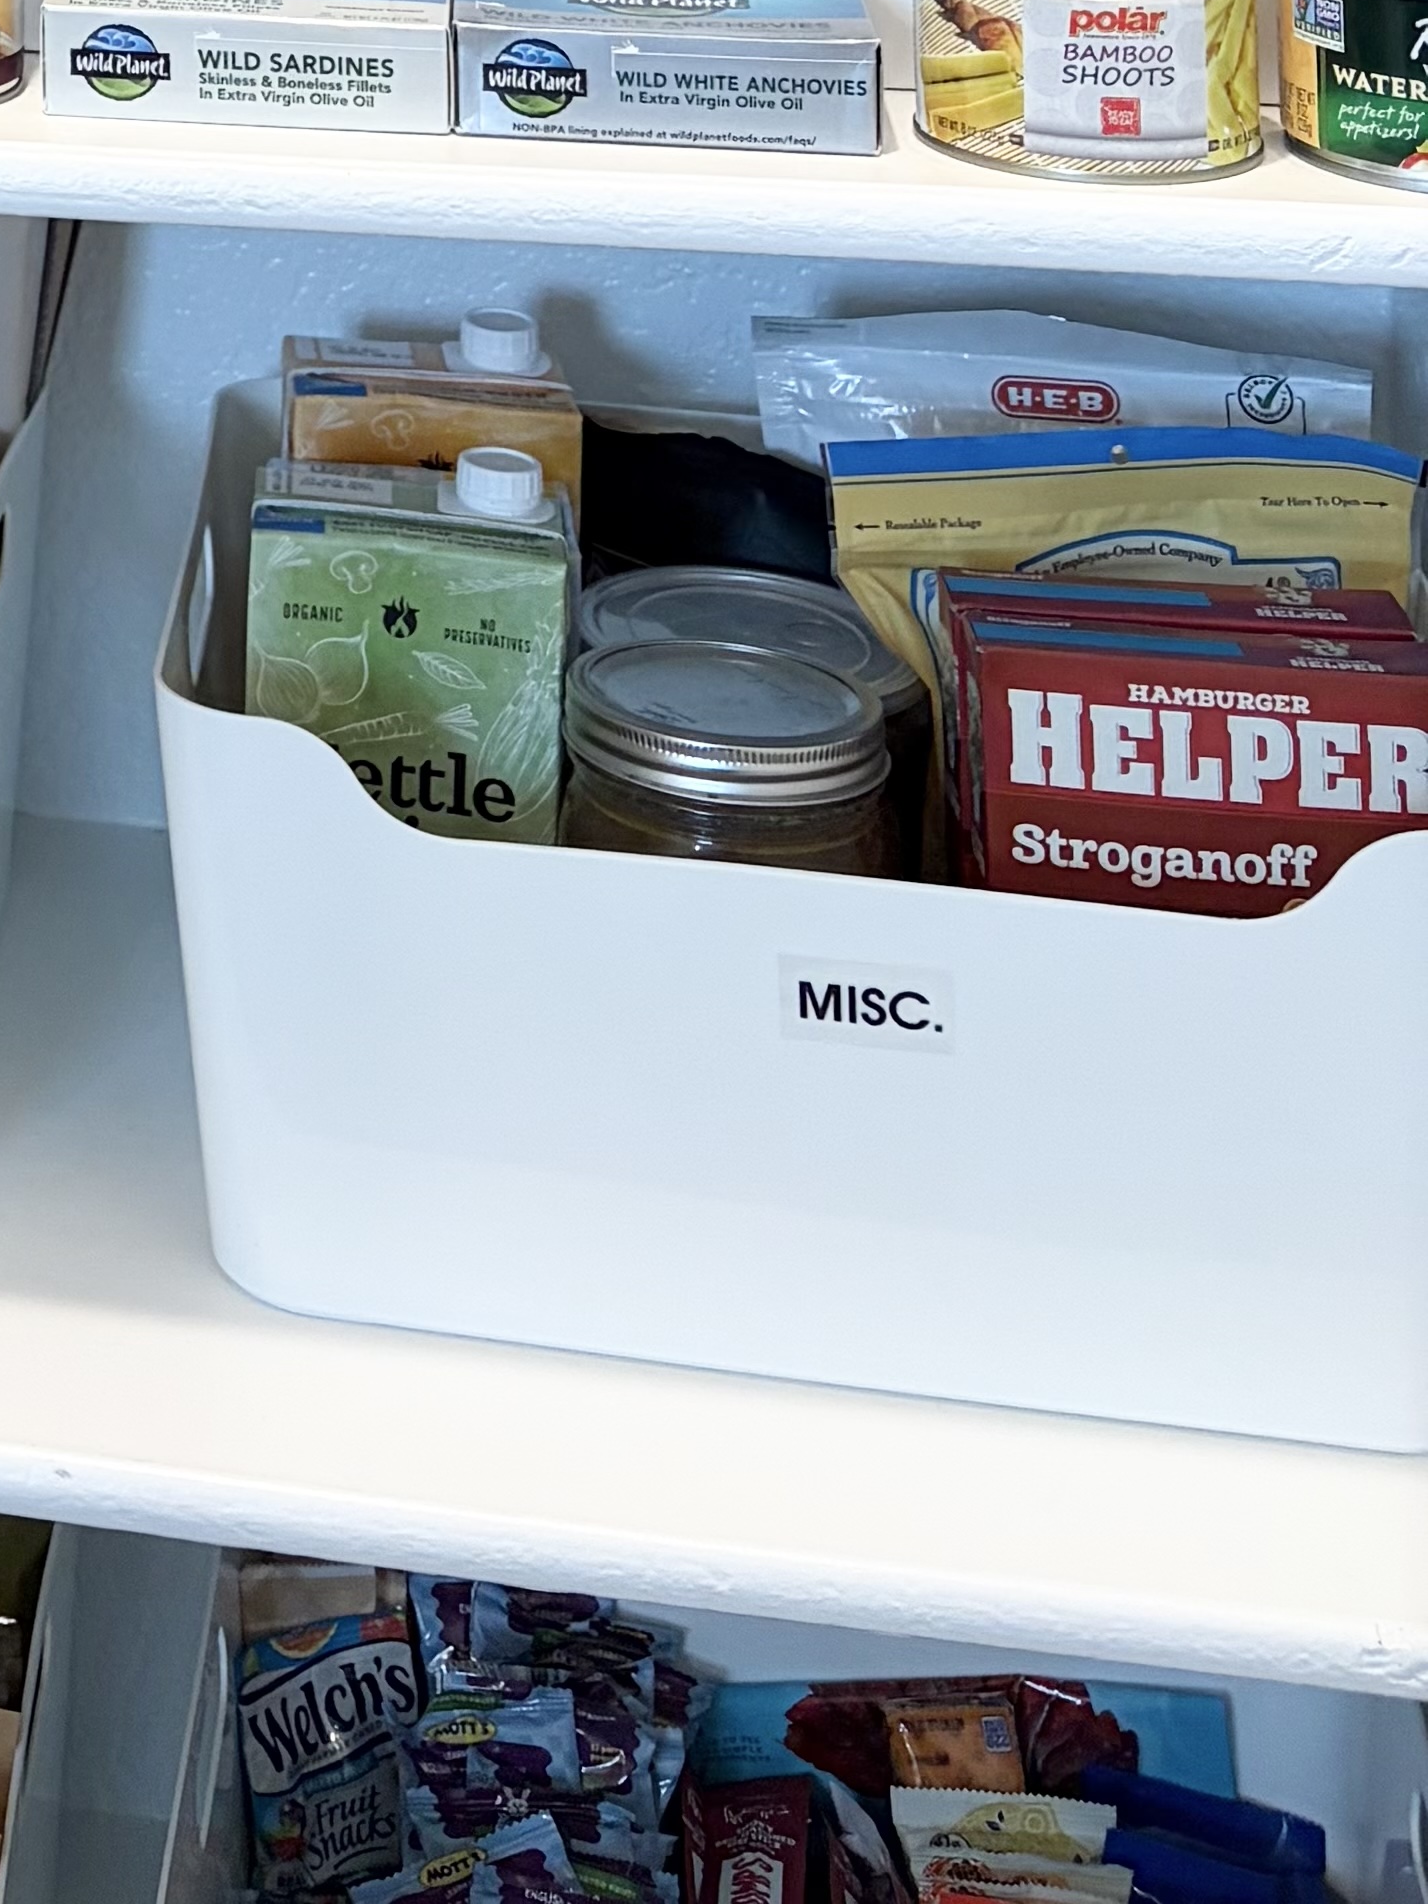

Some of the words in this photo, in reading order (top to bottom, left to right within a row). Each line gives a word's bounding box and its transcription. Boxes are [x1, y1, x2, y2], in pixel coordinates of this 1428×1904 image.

[198, 49, 261, 72] WILD
[269, 53, 395, 78] SARDINES
[1062, 42, 1174, 64] BAMBOO
[199, 72, 257, 89] Skinless
[261, 75, 274, 89] &
[277, 76, 344, 92] Boneless
[347, 78, 393, 94] Fillets
[616, 70, 667, 89] WILD
[674, 72, 739, 92] WHITE
[746, 75, 868, 97] ANCHOVIES
[1061, 65, 1176, 87] SHOOTS
[1331, 63, 1428, 99] WATER
[512, 122, 566, 135] NON-BPA
[568, 125, 598, 139] lining
[601, 128, 654, 142] explained
[283, 603, 344, 623] ORGANIC
[480, 618, 496, 632] NO
[444, 628, 532, 654] PRESERVATIVES
[1128, 683, 1311, 716] HAMBURGER
[1007, 688, 1428, 816] HELPER
[1011, 823, 1319, 889] Stroganoff
[797, 980, 944, 1033] MISC.
[247, 1655, 415, 1773] Welch's
